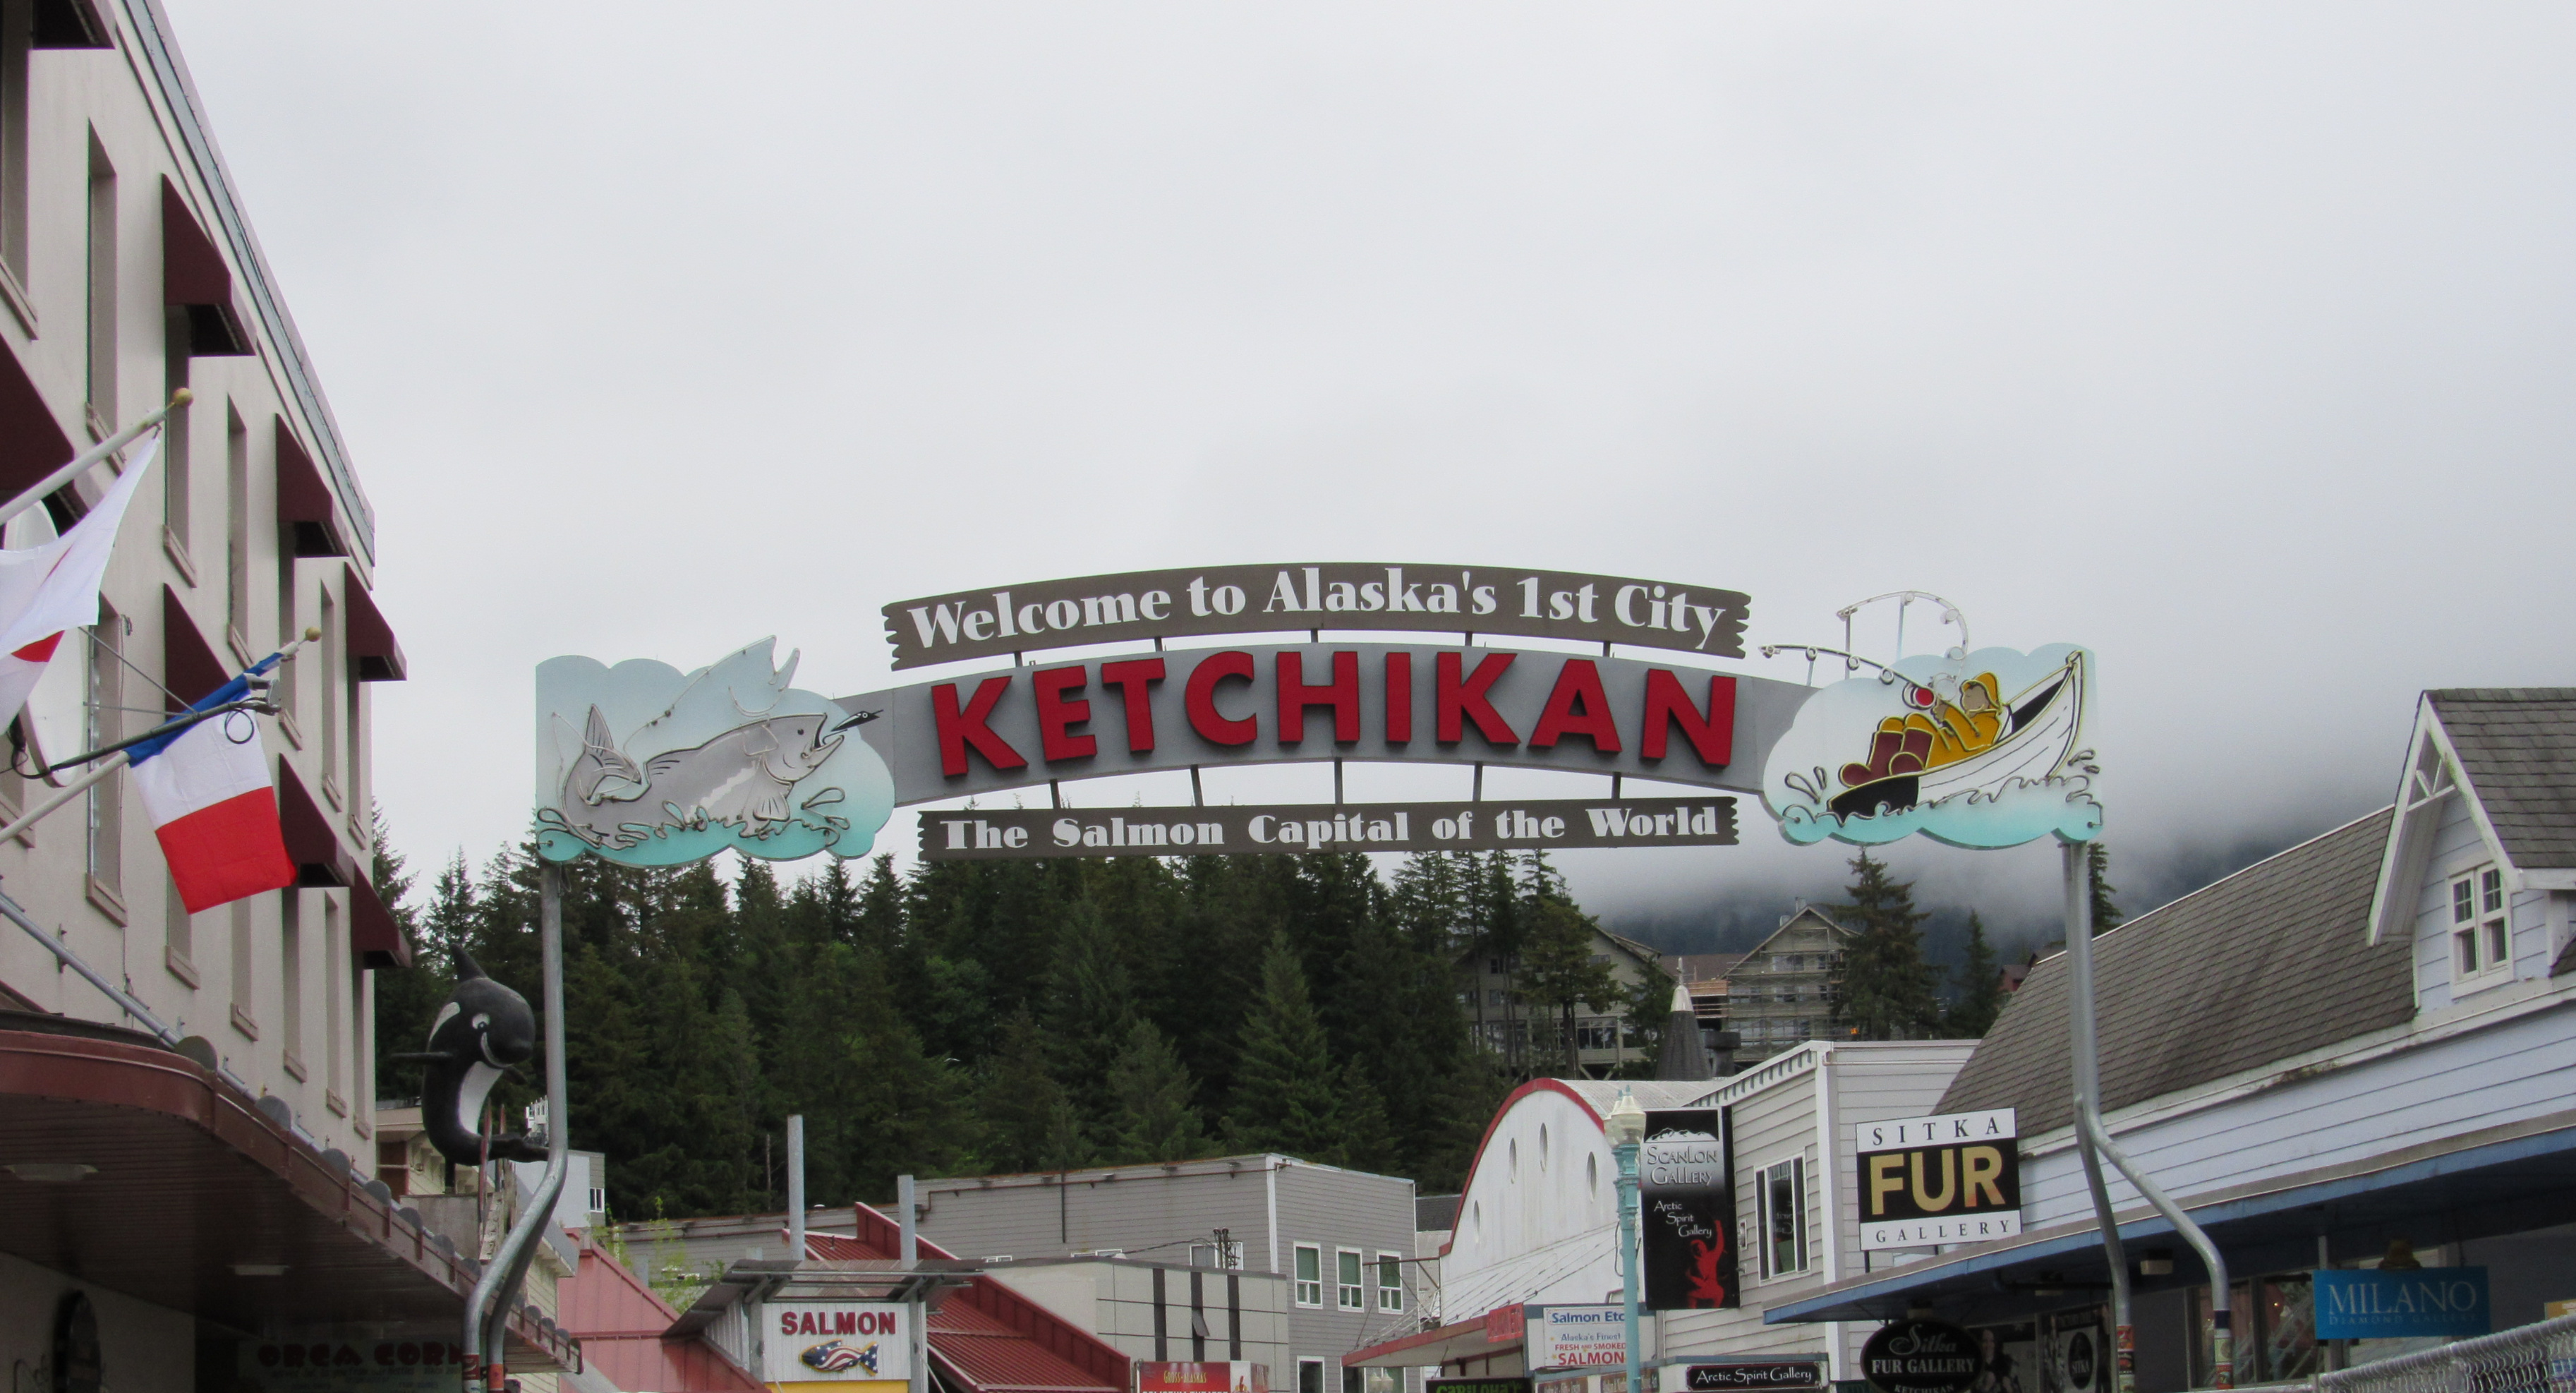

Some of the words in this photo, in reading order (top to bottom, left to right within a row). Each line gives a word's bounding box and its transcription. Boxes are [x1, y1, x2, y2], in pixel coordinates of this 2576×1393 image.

[907, 589, 1171, 649] Welcome
[1187, 576, 1246, 617] to
[1262, 567, 1497, 615] Alaska's
[1516, 577, 1600, 624] 1st
[1614, 585, 1727, 650] City
[931, 650, 1737, 778] KETCHIKAN
[939, 819, 1028, 850] The
[1052, 816, 1225, 848] Salmon
[1247, 812, 1409, 850] Capital
[1432, 810, 1473, 840] of
[1494, 809, 1565, 839] the
[1585, 806, 1718, 838] World
[1873, 1116, 2000, 1146] SITKA
[1870, 1145, 2006, 1215] FUR
[1654, 1200, 1683, 1212] Arctic
[1666, 1212, 1695, 1226] Spirit
[1678, 1224, 1712, 1238] Gallery
[1876, 1219, 2009, 1243] GALLERY
[2328, 1281, 2477, 1315] MILANO
[781, 1312, 896, 1335] SALMON
[1552, 1312, 1600, 1323] Salmon
[1605, 1311, 1625, 1322] Etc
[1889, 1323, 1957, 1355] Sitka
[258, 1343, 363, 1367] ORCA
[1558, 1351, 1625, 1365] SALMON
[1871, 1358, 1903, 1374] FUR
[1906, 1357, 1976, 1374] GALLERY
[1695, 1370, 1731, 1384] Arctic
[1734, 1368, 1767, 1385] Spirit
[1770, 1367, 1812, 1382] Gallery
